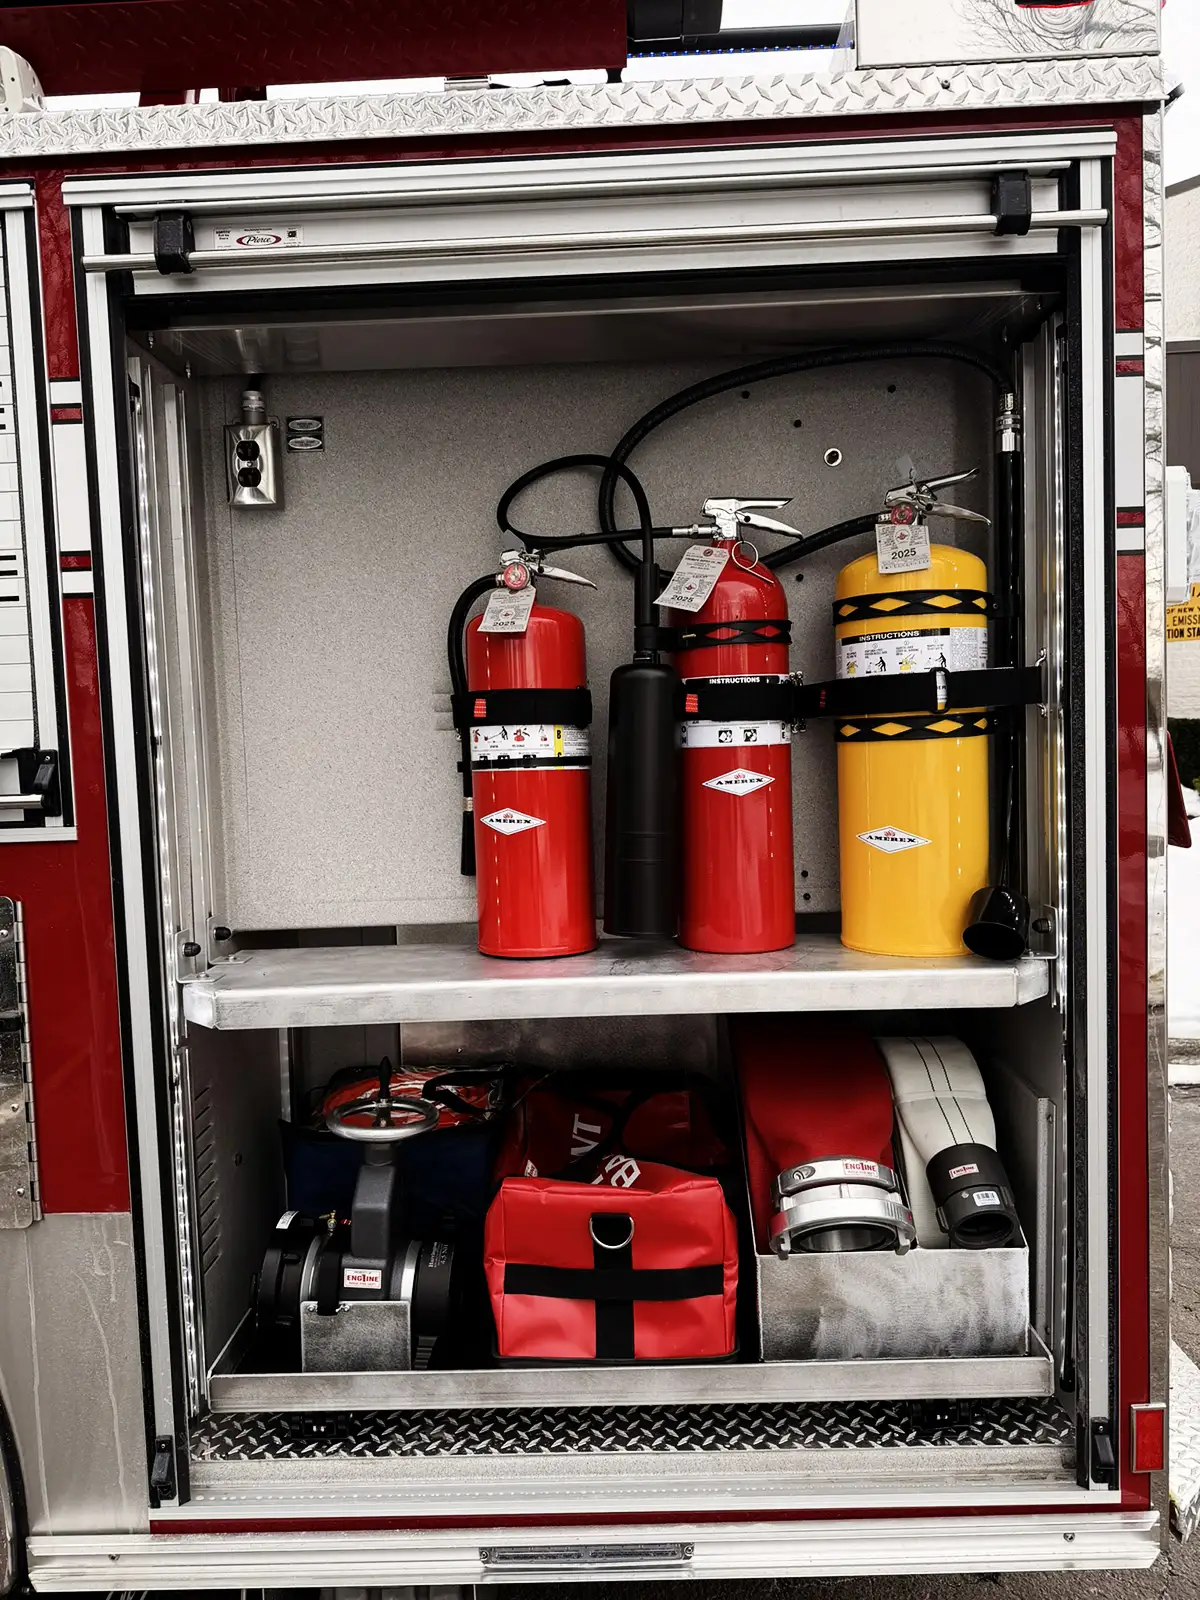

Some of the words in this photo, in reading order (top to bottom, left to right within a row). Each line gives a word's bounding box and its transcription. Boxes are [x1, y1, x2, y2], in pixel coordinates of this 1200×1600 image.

[246, 234, 272, 245] Pierce
[891, 547, 917, 560] 2025
[671, 594, 695, 603] 2025
[859, 630, 920, 642] INSTRUCTIONS
[1167, 628, 1185, 639] TION
[709, 677, 761, 685] INSTRUCTIONS
[715, 777, 764, 786] AMEREX
[867, 835, 917, 843] AMEREX
